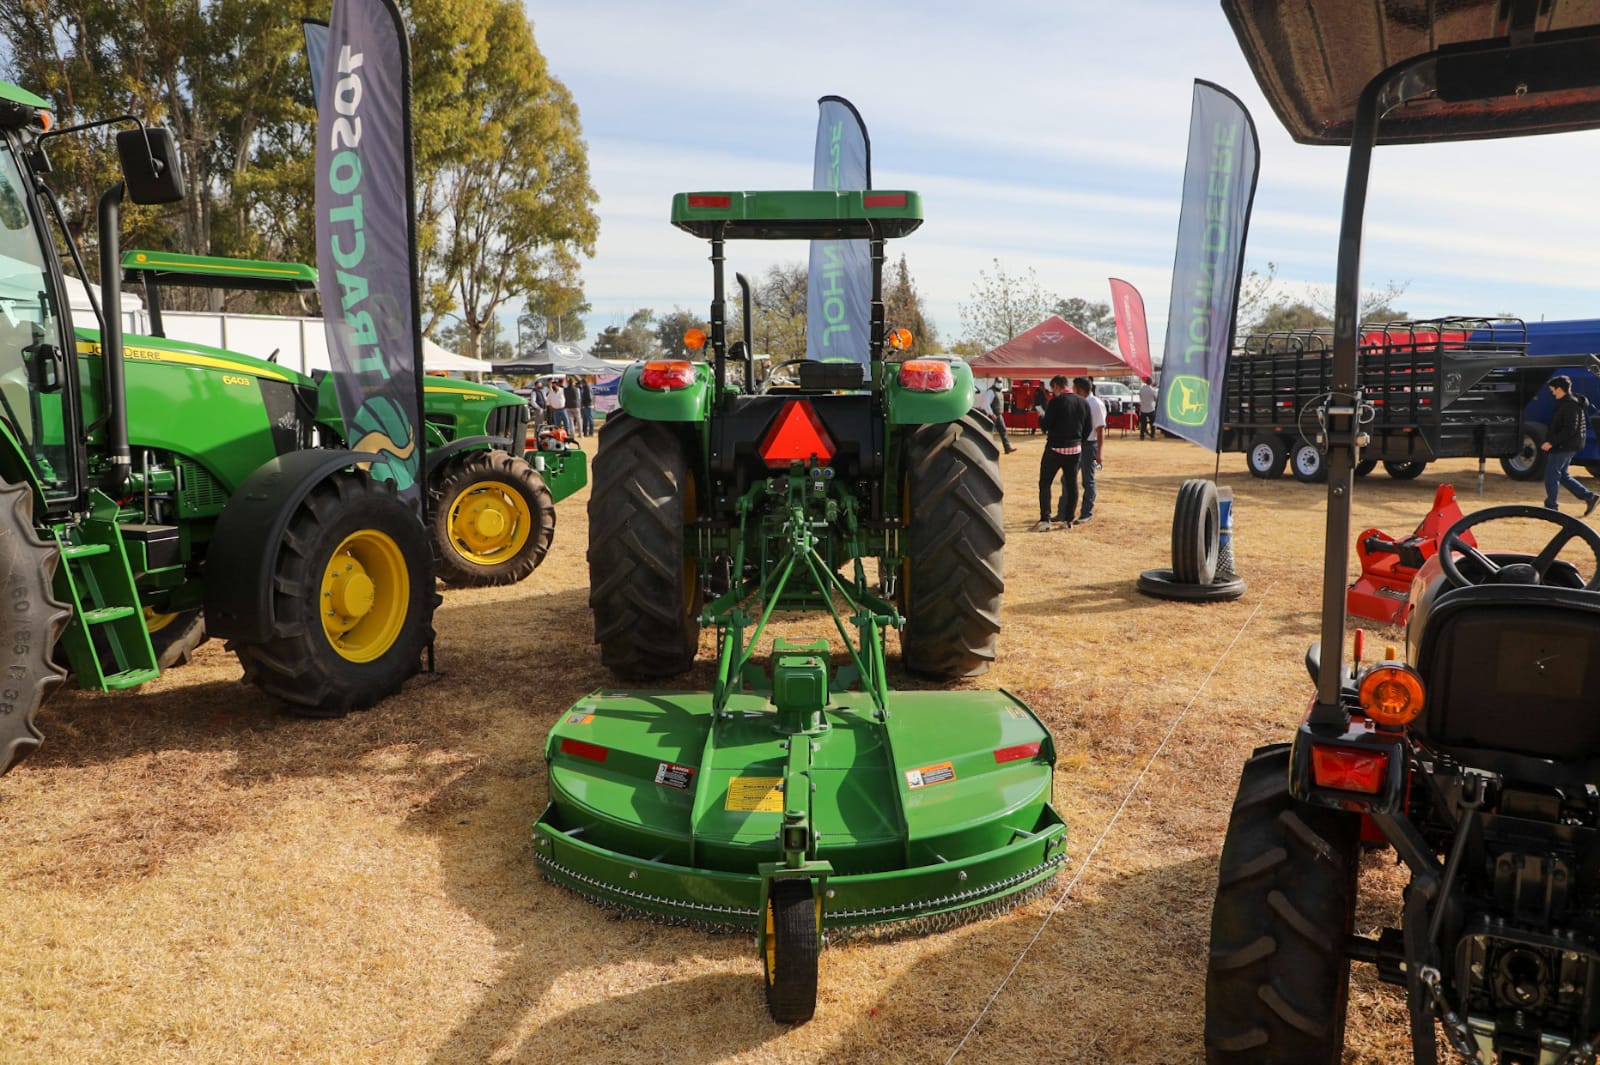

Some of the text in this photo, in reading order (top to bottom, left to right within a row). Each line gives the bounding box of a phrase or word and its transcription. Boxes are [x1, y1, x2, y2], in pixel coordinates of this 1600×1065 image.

[88, 344, 161, 360] JO DEERE
[222, 374, 251, 387] 6403
